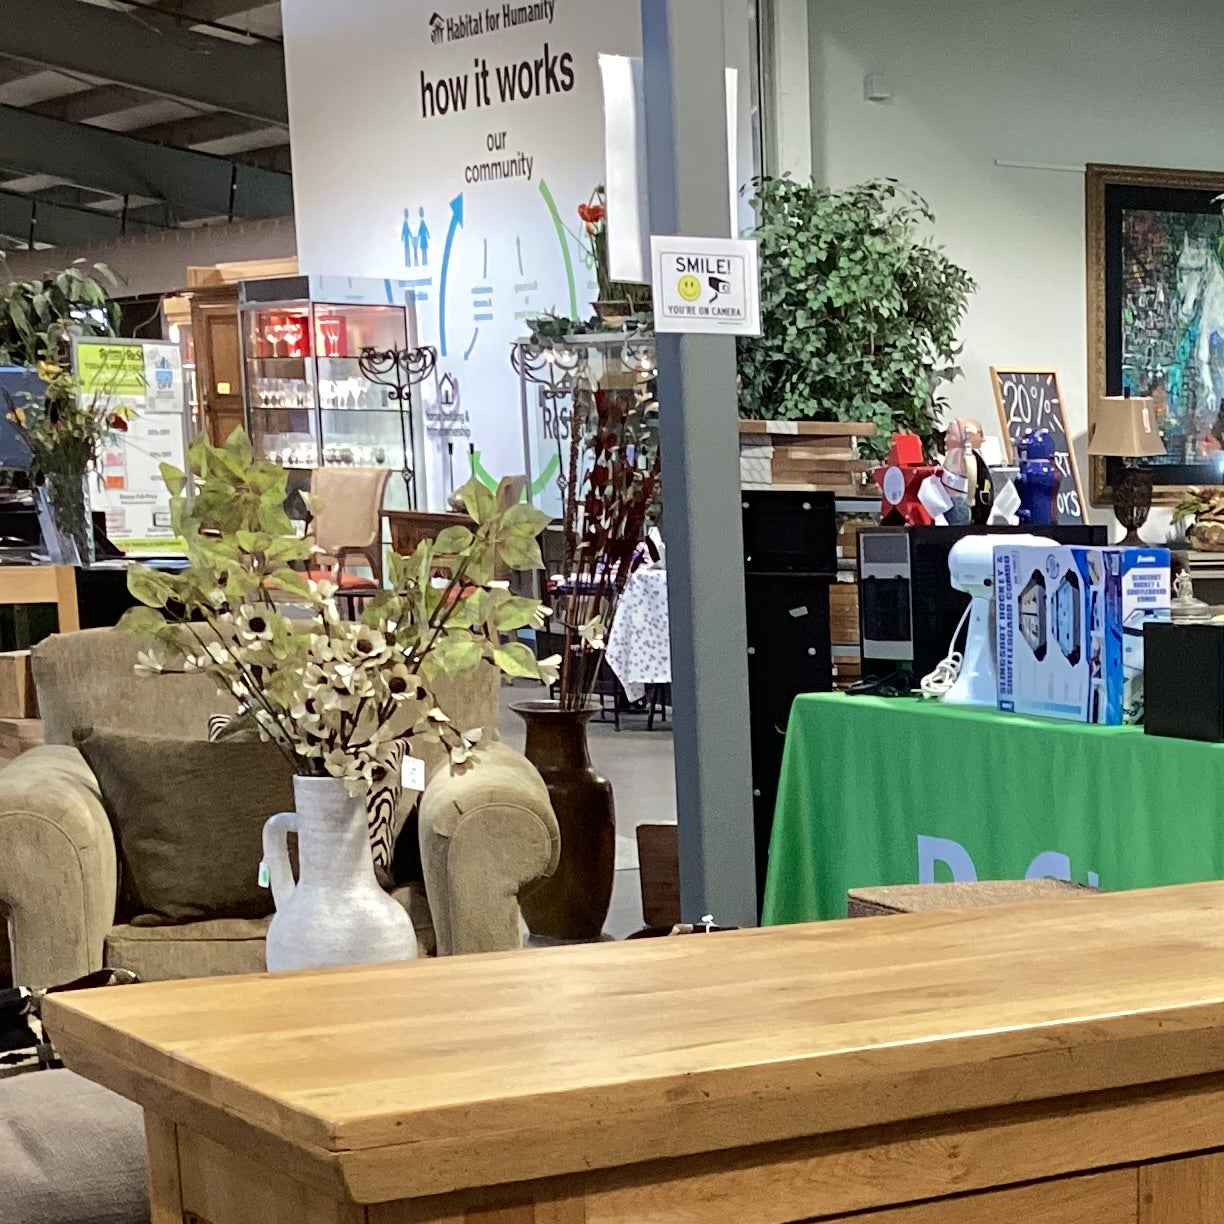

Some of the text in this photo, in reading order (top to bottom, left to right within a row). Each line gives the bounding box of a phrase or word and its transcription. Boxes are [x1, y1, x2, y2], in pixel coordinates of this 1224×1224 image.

[446, 0, 555, 42] Habitat for Humanity
[420, 43, 575, 118] how it works
[486, 131, 507, 151] our
[464, 151, 534, 183] community
[675, 256, 731, 275] SMILE!
[667, 305, 742, 317] YOU'RE ON CAMERA
[1003, 380, 1051, 427] 20%
[998, 569, 1006, 620] HOCKEY
[1004, 555, 1013, 601] COMBO
